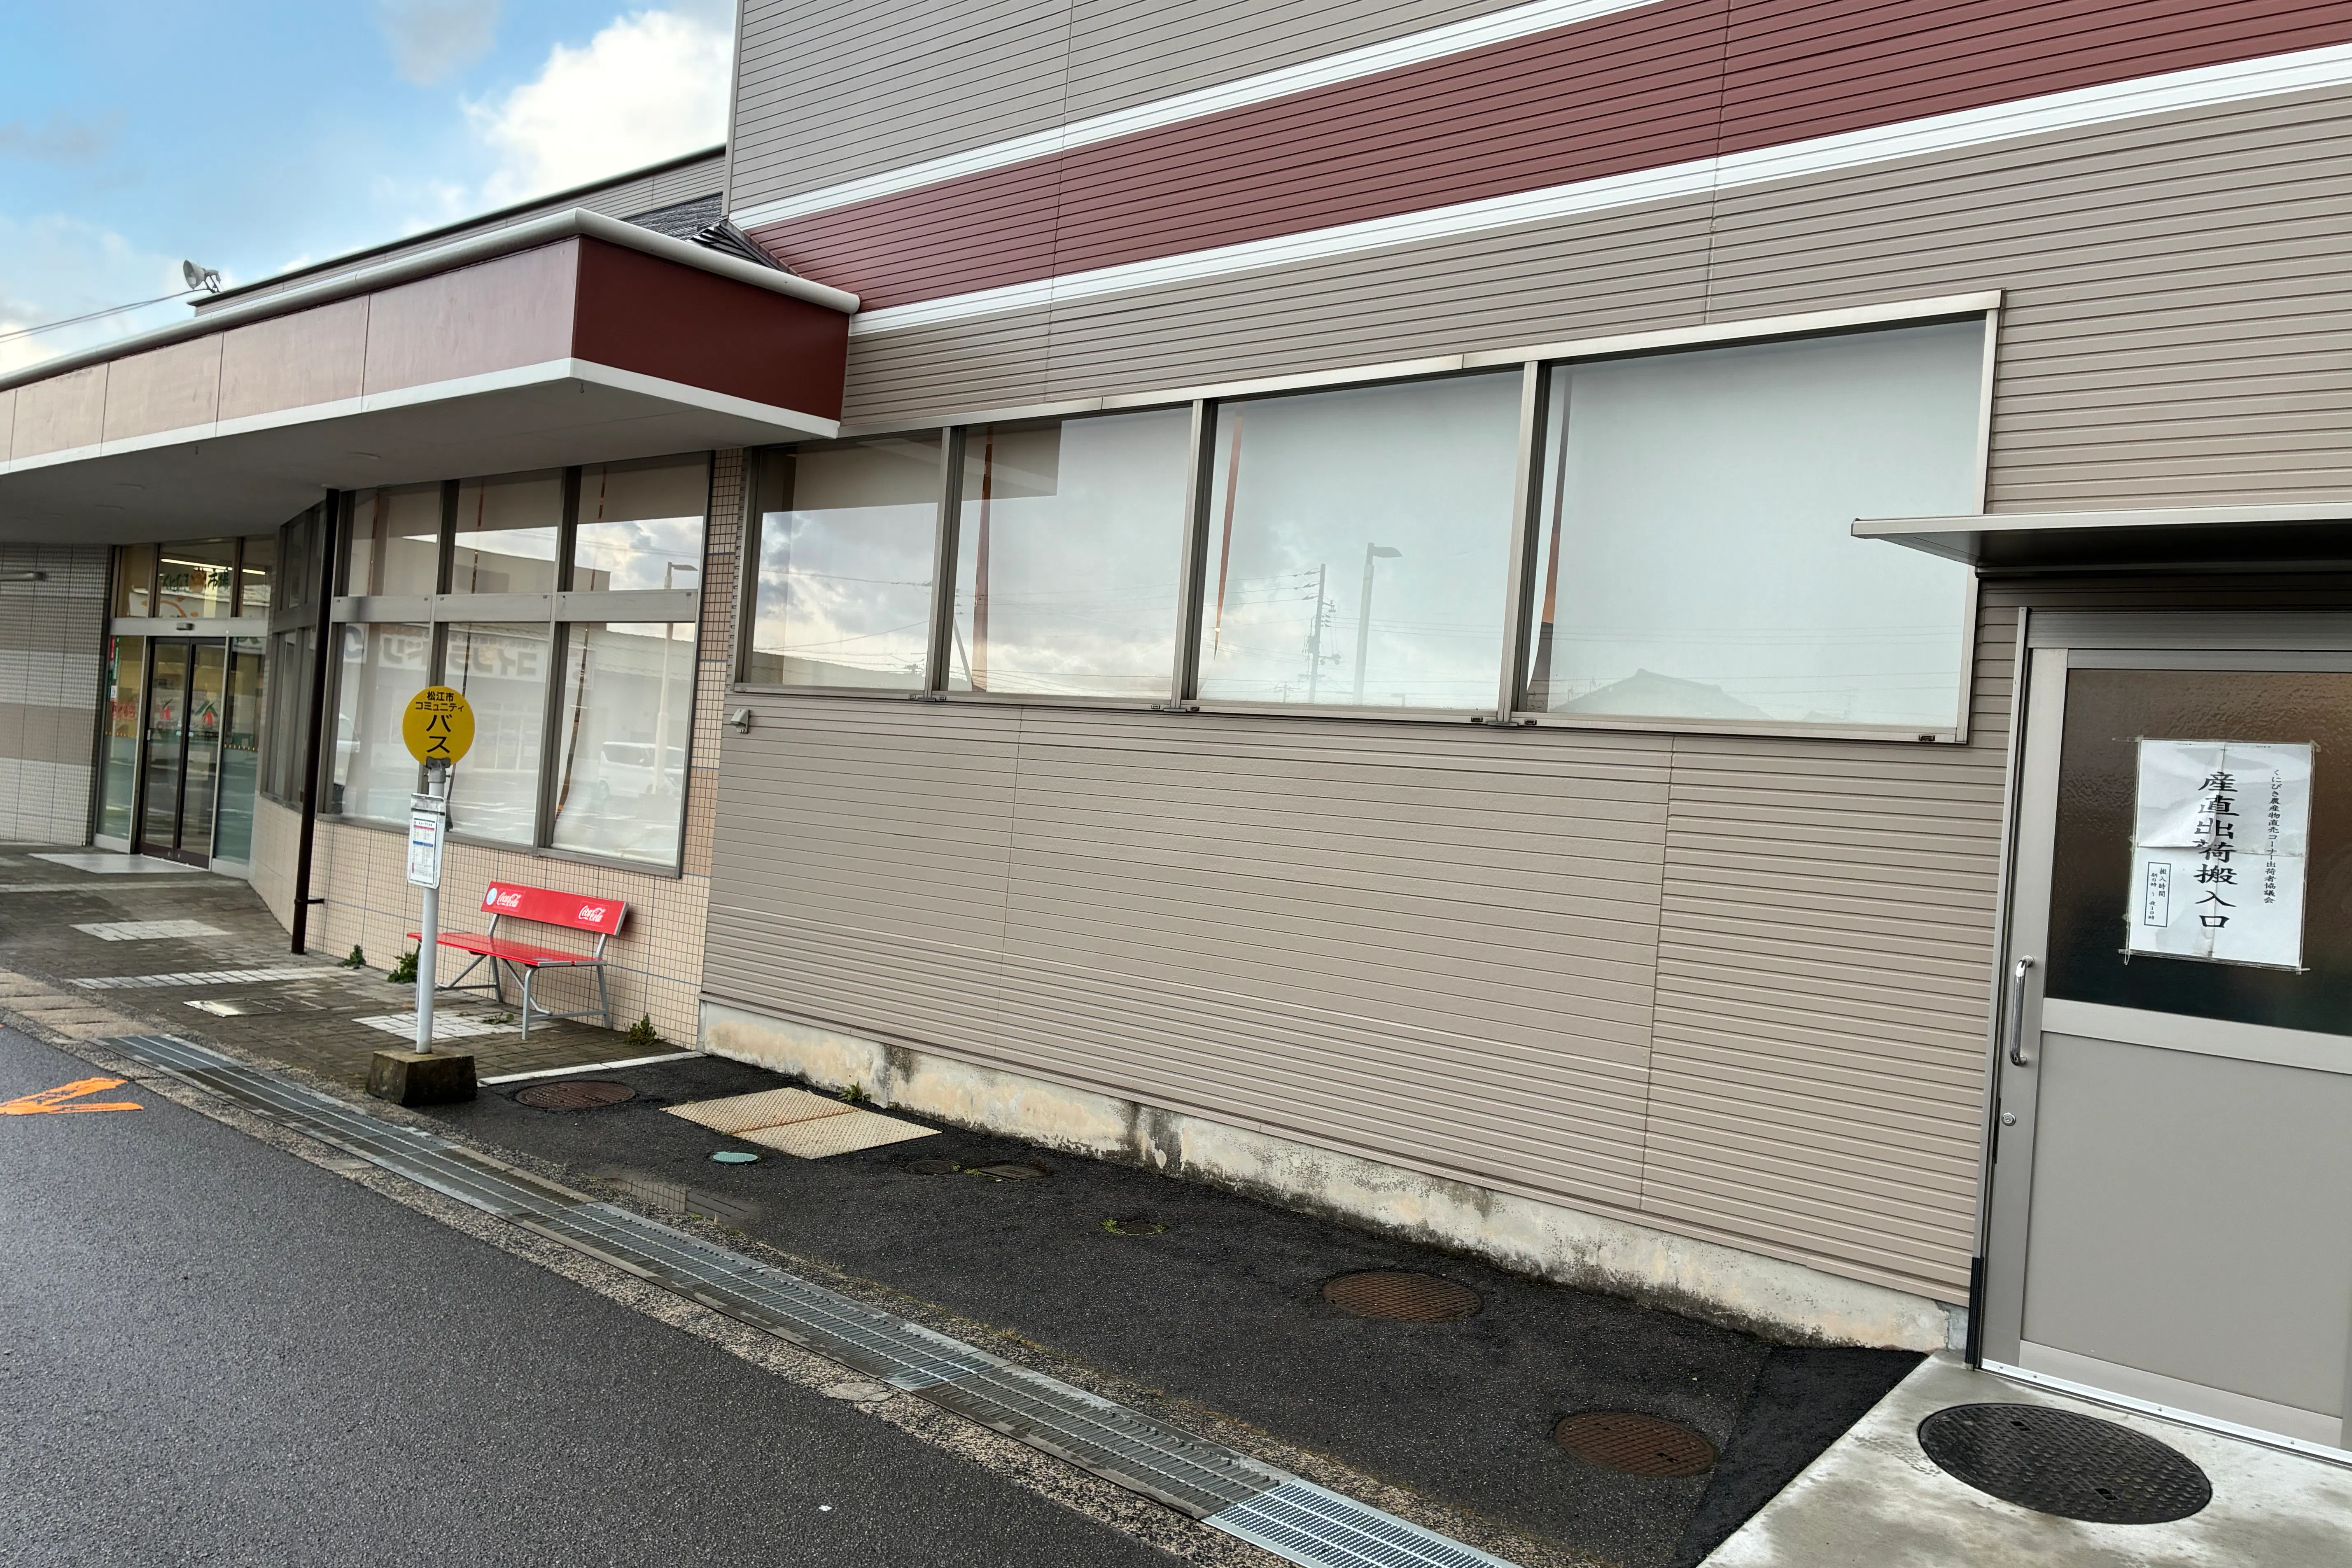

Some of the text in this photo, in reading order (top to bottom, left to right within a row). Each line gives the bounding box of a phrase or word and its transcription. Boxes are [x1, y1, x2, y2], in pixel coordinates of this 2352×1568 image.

[415, 701, 464, 712] コミュニティ
[427, 691, 454, 702] 松江市
[426, 714, 453, 754] バス
[2192, 771, 2240, 928] 産直出荷搬入口
[2264, 769, 2282, 904] くにびき農産物直売コーナー出荷者協議会
[2159, 867, 2167, 898] 搬入時間
